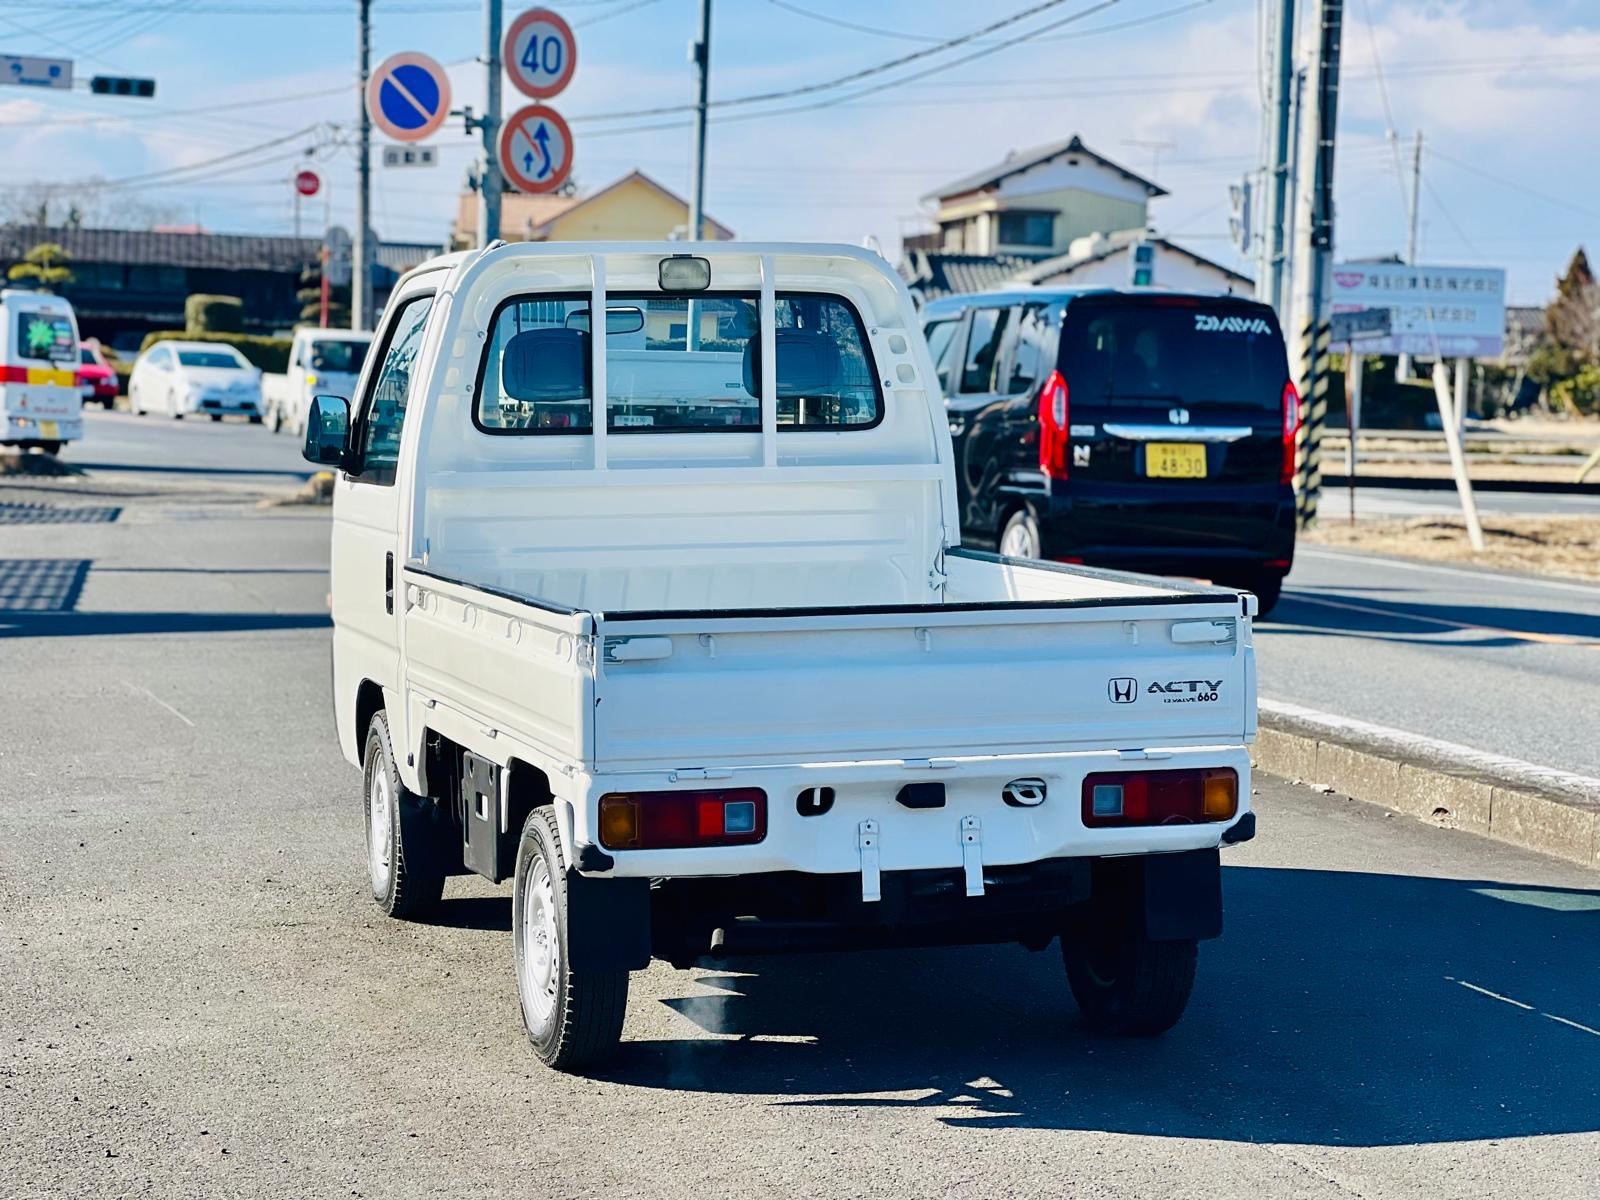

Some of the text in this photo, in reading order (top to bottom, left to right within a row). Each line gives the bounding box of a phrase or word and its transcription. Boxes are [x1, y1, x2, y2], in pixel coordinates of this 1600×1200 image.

[522, 34, 562, 75] 40
[1195, 315, 1271, 335] DAIWA
[1148, 680, 1223, 693] ACTY
[1197, 692, 1218, 702] 660
